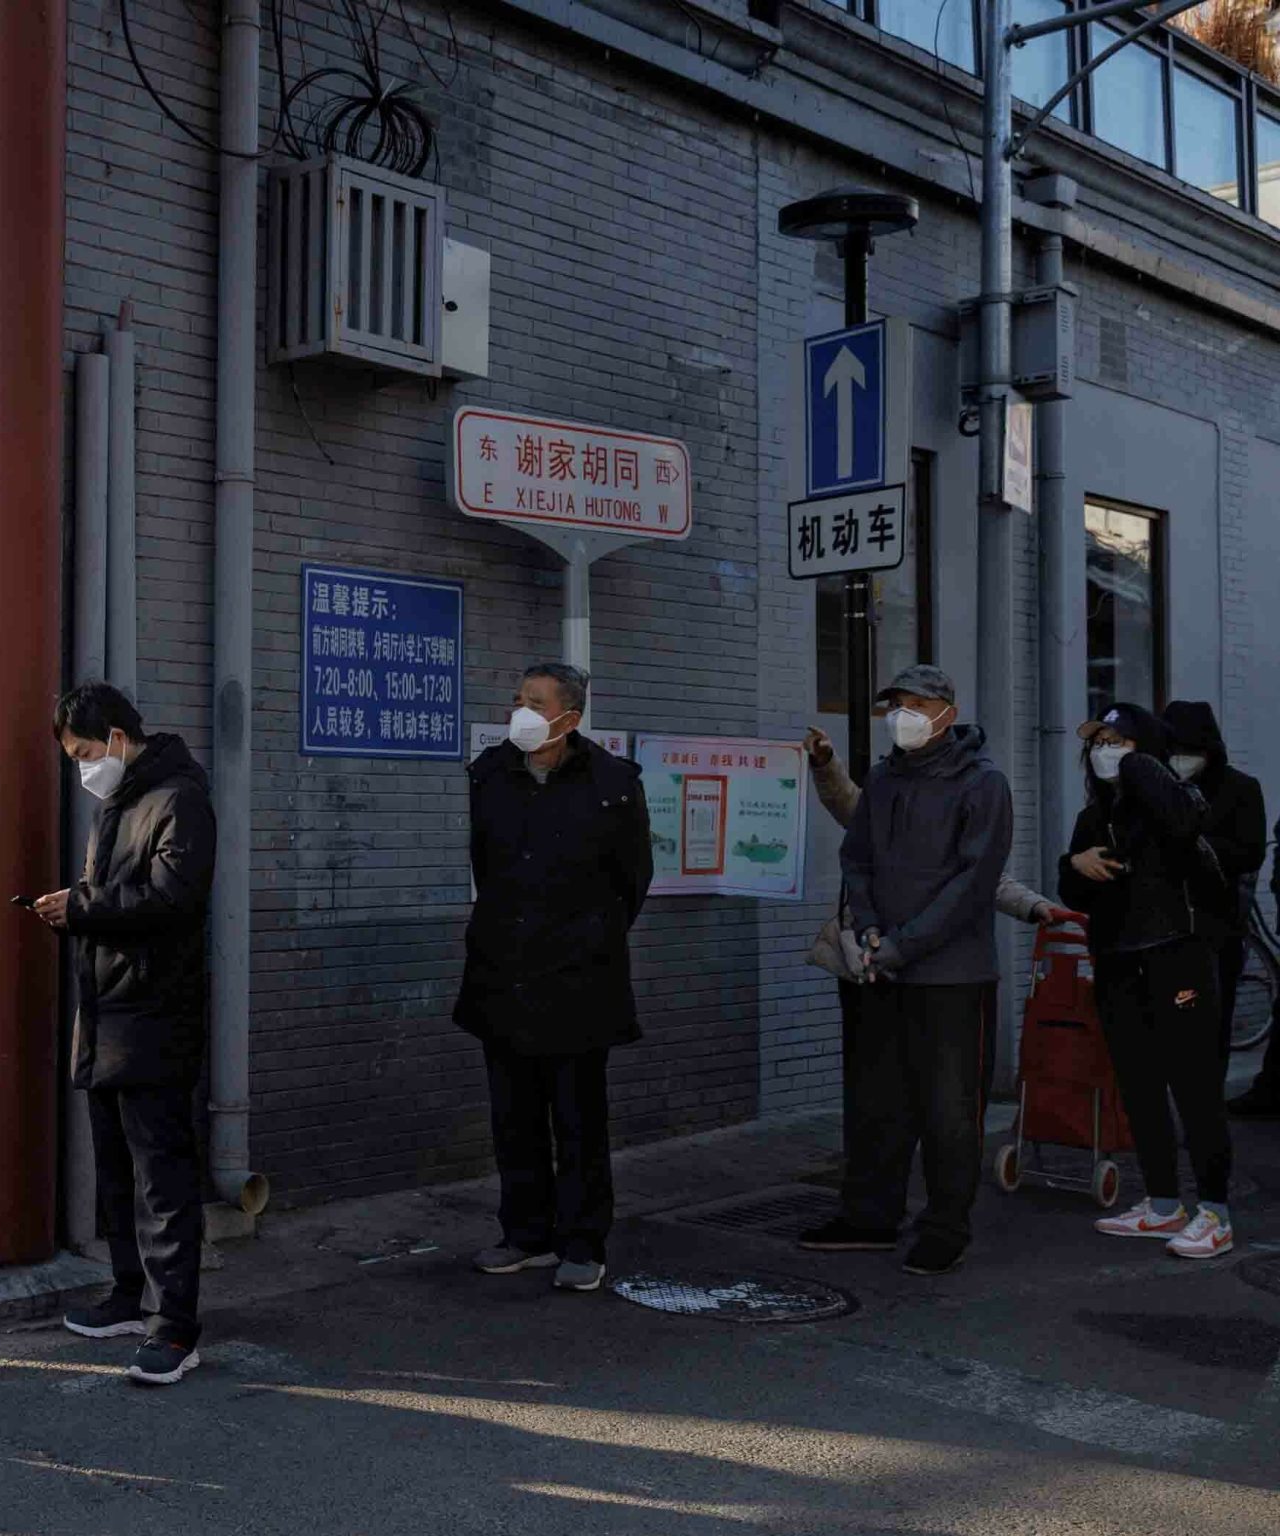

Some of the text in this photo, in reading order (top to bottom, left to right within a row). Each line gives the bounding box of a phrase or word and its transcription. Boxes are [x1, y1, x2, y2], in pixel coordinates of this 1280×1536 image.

[479, 434, 672, 491] 东 谢家胡同 西
[484, 482, 669, 524] E XIEJIA HUTONG W
[798, 503, 896, 562] 机动车
